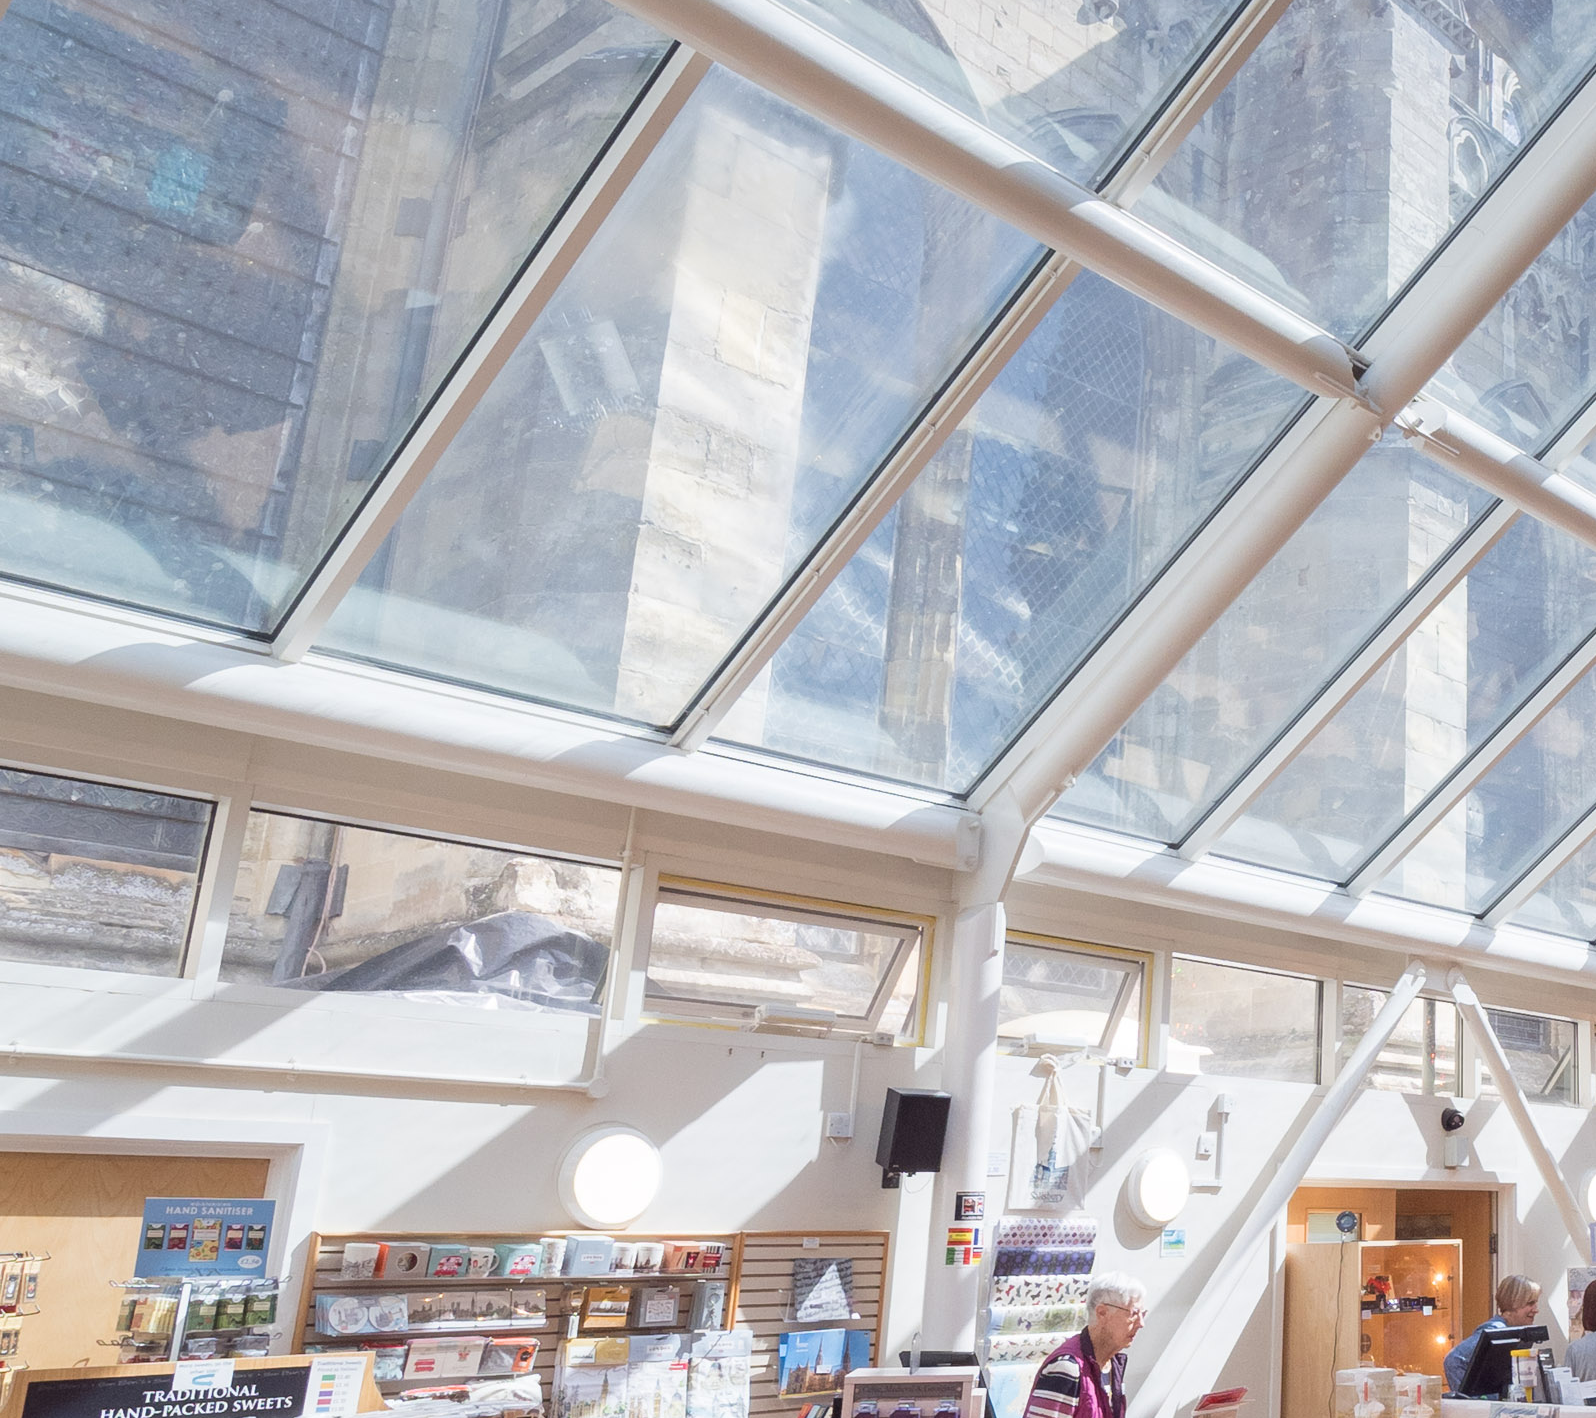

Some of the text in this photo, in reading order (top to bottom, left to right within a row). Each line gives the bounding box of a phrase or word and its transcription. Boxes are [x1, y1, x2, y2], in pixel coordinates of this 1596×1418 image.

[166, 1206, 254, 1216] HAND SANITISER
[143, 1384, 259, 1404] TRADITIONAL
[232, 1396, 293, 1413] SWEETS
